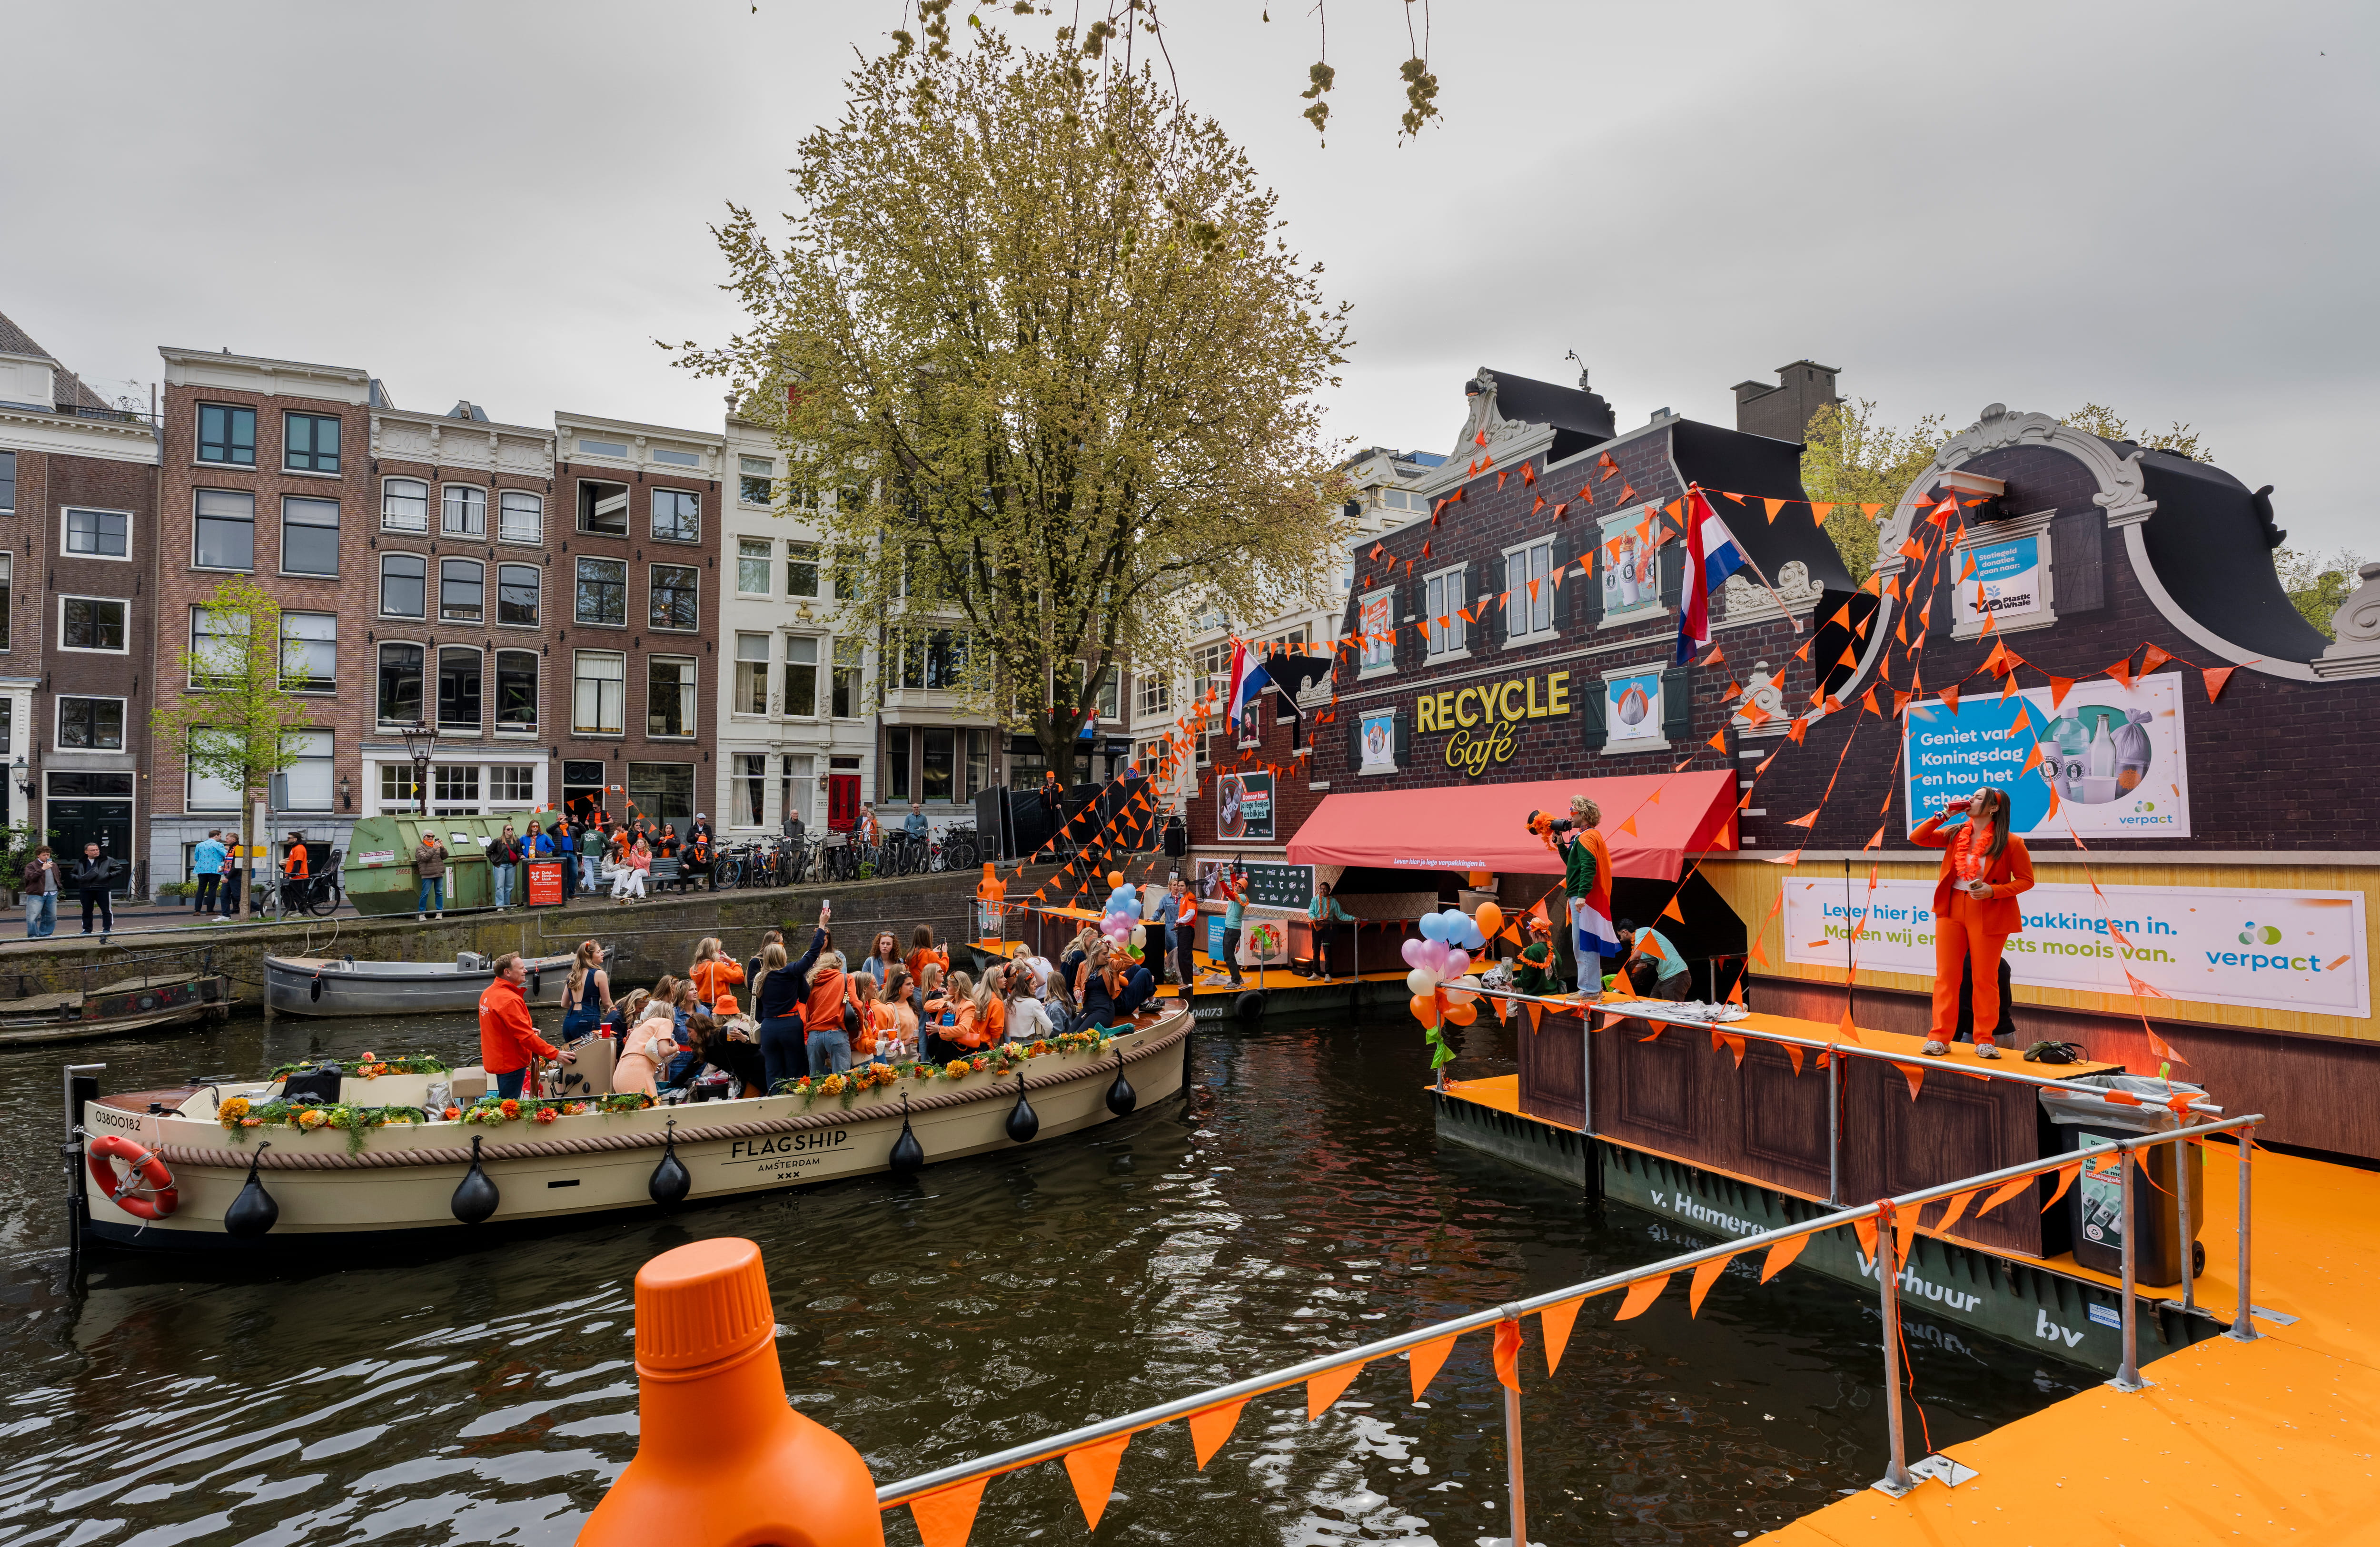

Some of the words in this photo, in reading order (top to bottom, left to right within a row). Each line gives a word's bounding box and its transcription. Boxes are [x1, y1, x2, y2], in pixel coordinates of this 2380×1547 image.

[1979, 548, 2017, 561] Statiegeld
[1982, 556, 2015, 568] donaties
[1980, 567, 1999, 576] gaan
[2000, 563, 2020, 572] naar:
[2003, 594, 2031, 603] Plastic
[2003, 600, 2031, 609] Whale
[1417, 670, 1570, 733] RECYCLE
[1921, 729, 1977, 746] Geniet
[1446, 720, 1518, 776] Café
[1922, 747, 2024, 766] Koningsdag
[1922, 775, 1943, 786] en
[1947, 771, 1978, 784] hou
[1983, 769, 2013, 782] het
[1245, 801, 1254, 809] lege
[1254, 801, 1269, 809] flesjes
[1250, 810, 1266, 819] blikjes.
[2119, 815, 2173, 826] verpact
[1426, 859, 1438, 867] lege
[1438, 860, 1478, 868] verpakkingen
[1824, 903, 1869, 918] Lever
[1874, 904, 1908, 920] hier
[1912, 906, 1929, 925] je
[2147, 916, 2178, 935] in.
[1886, 928, 1912, 947] wij
[2004, 938, 2036, 952] ets
[2043, 940, 2114, 958] moois
[2120, 946, 2176, 963] van.
[2205, 951, 2321, 972] verpact
[96, 1111, 140, 1131] 03800182
[732, 1130, 847, 1158] FLAGSHIP
[758, 1157, 820, 1172] AMSTERDAM
[1651, 1190, 1667, 1208] v.
[1675, 1192, 1772, 1236] Hamere
[2036, 1309, 2084, 1348] bv
